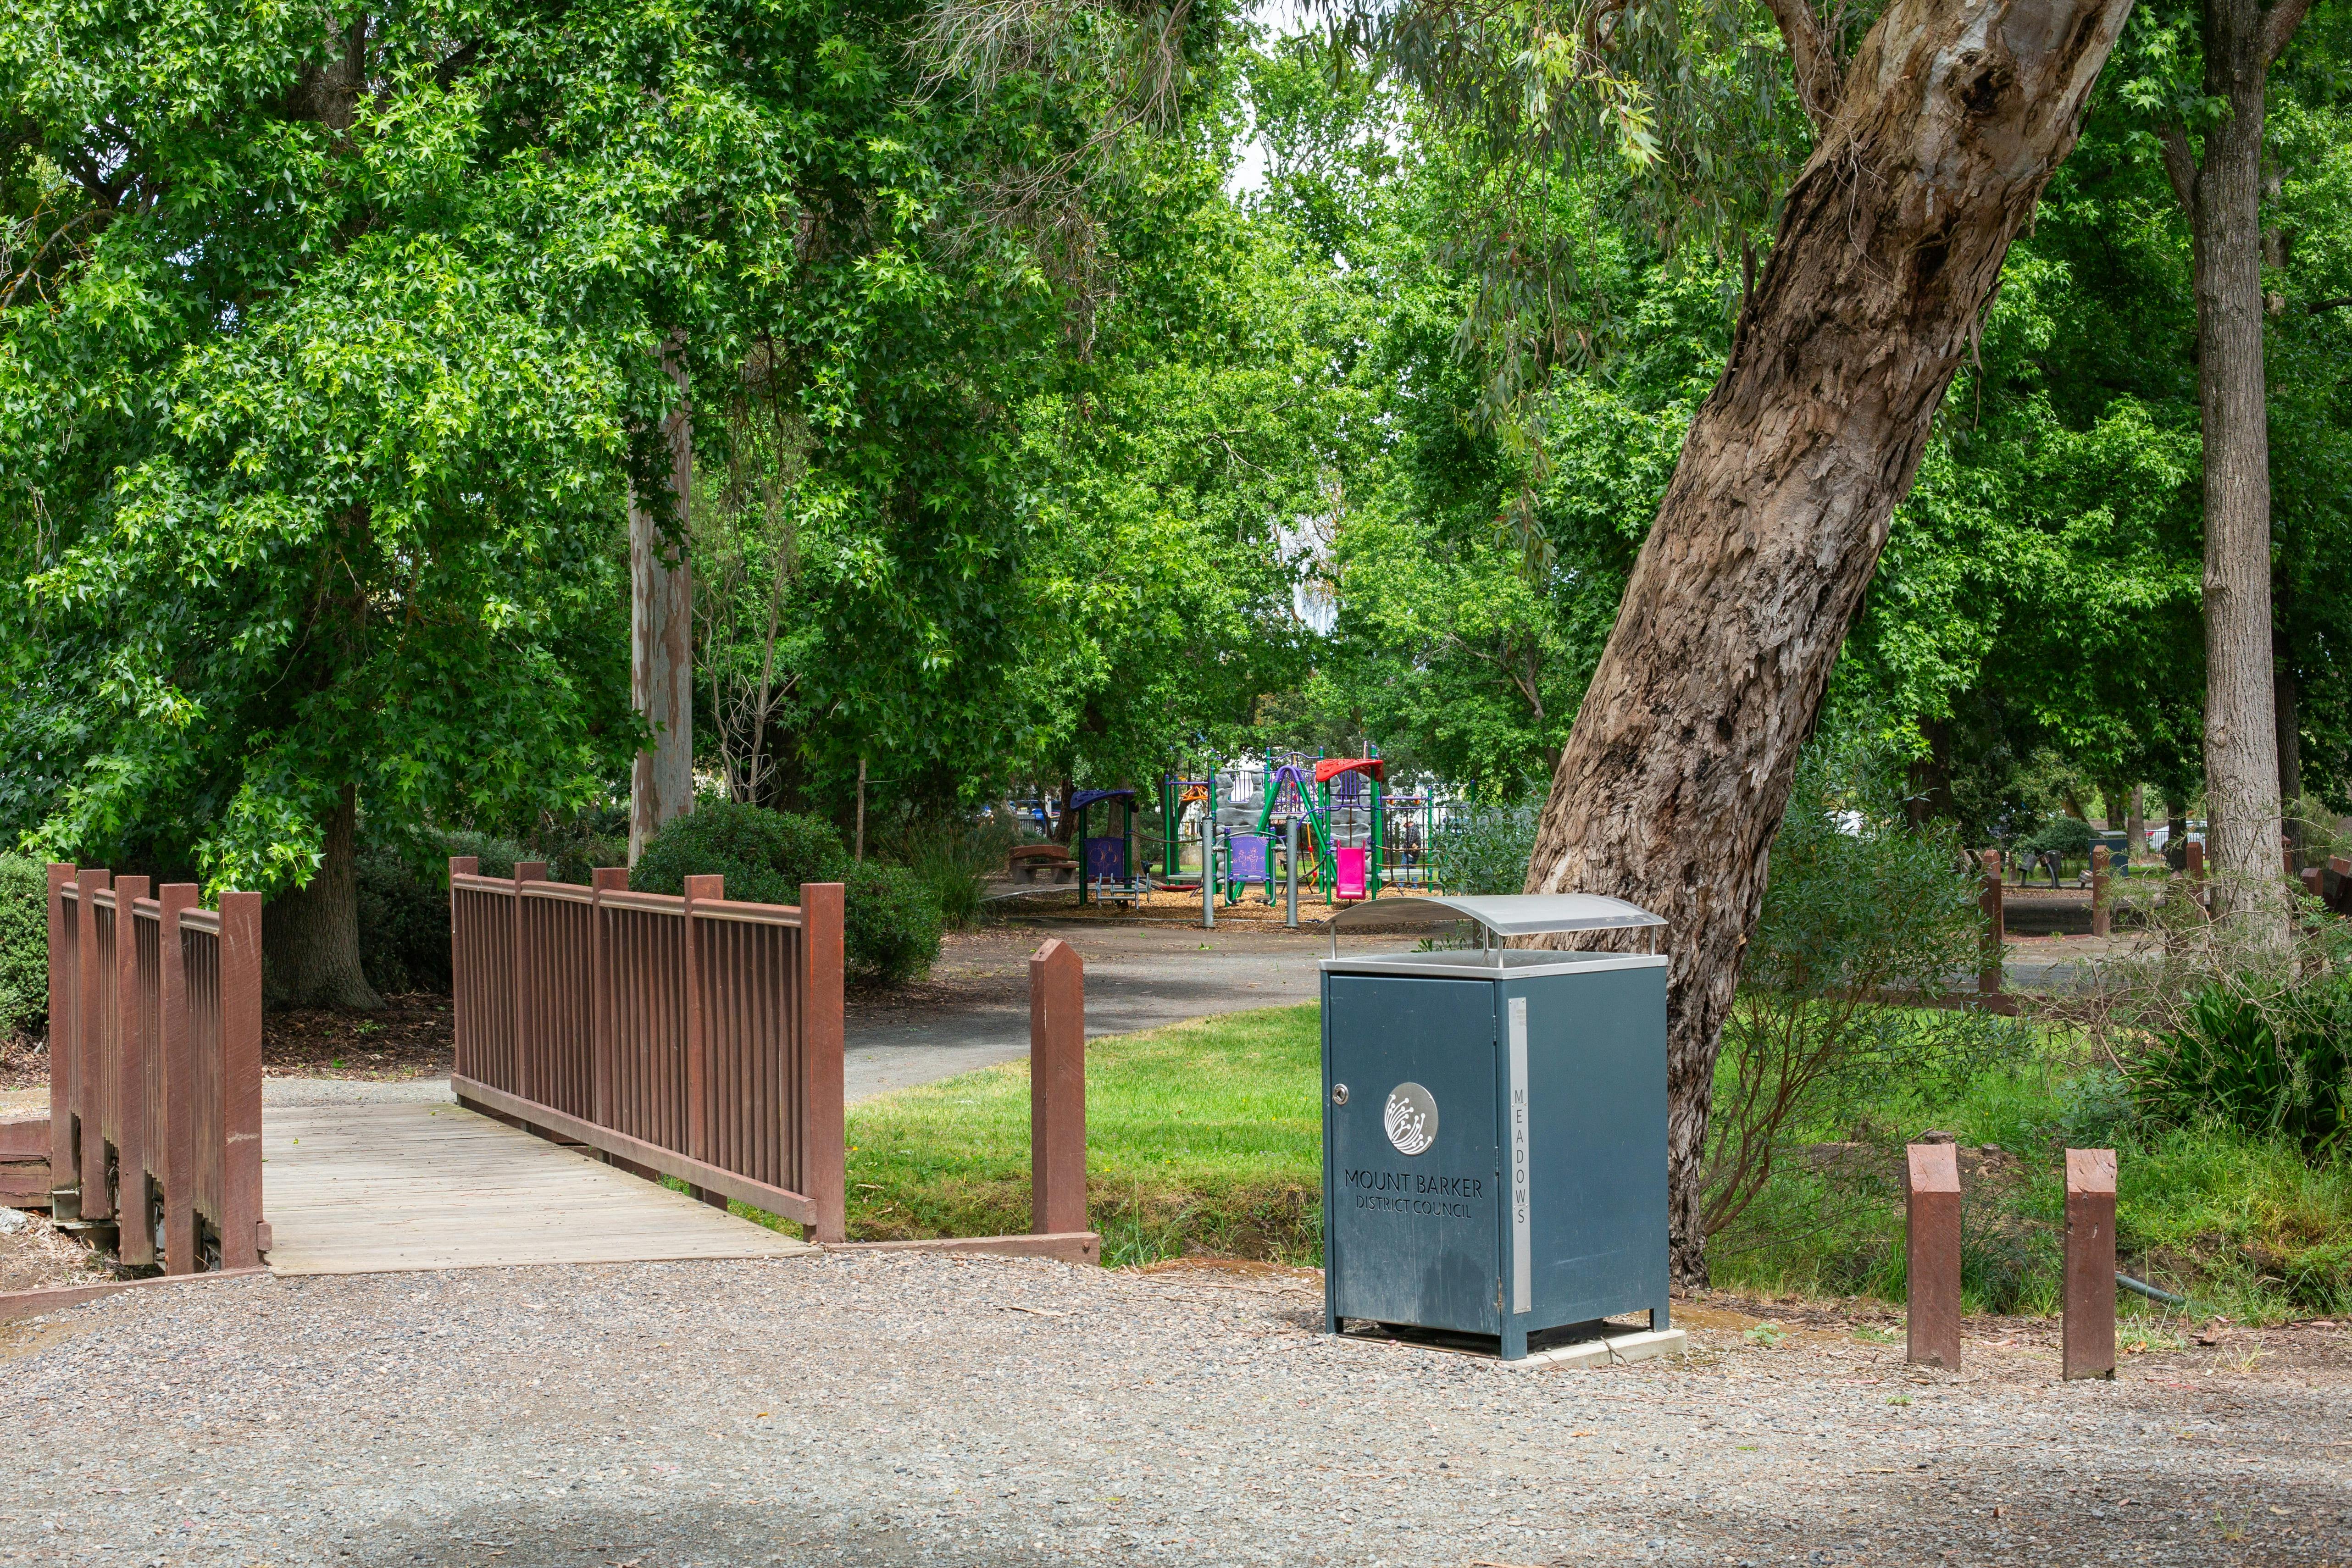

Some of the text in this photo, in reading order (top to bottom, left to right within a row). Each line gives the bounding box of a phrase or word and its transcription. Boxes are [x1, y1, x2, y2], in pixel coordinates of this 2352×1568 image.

[1514, 1088, 1526, 1224] MEADOWS
[1345, 1169, 1483, 1199] MOUNT BARKER
[1356, 1195, 1472, 1219] DISTRICT COUNCIL
